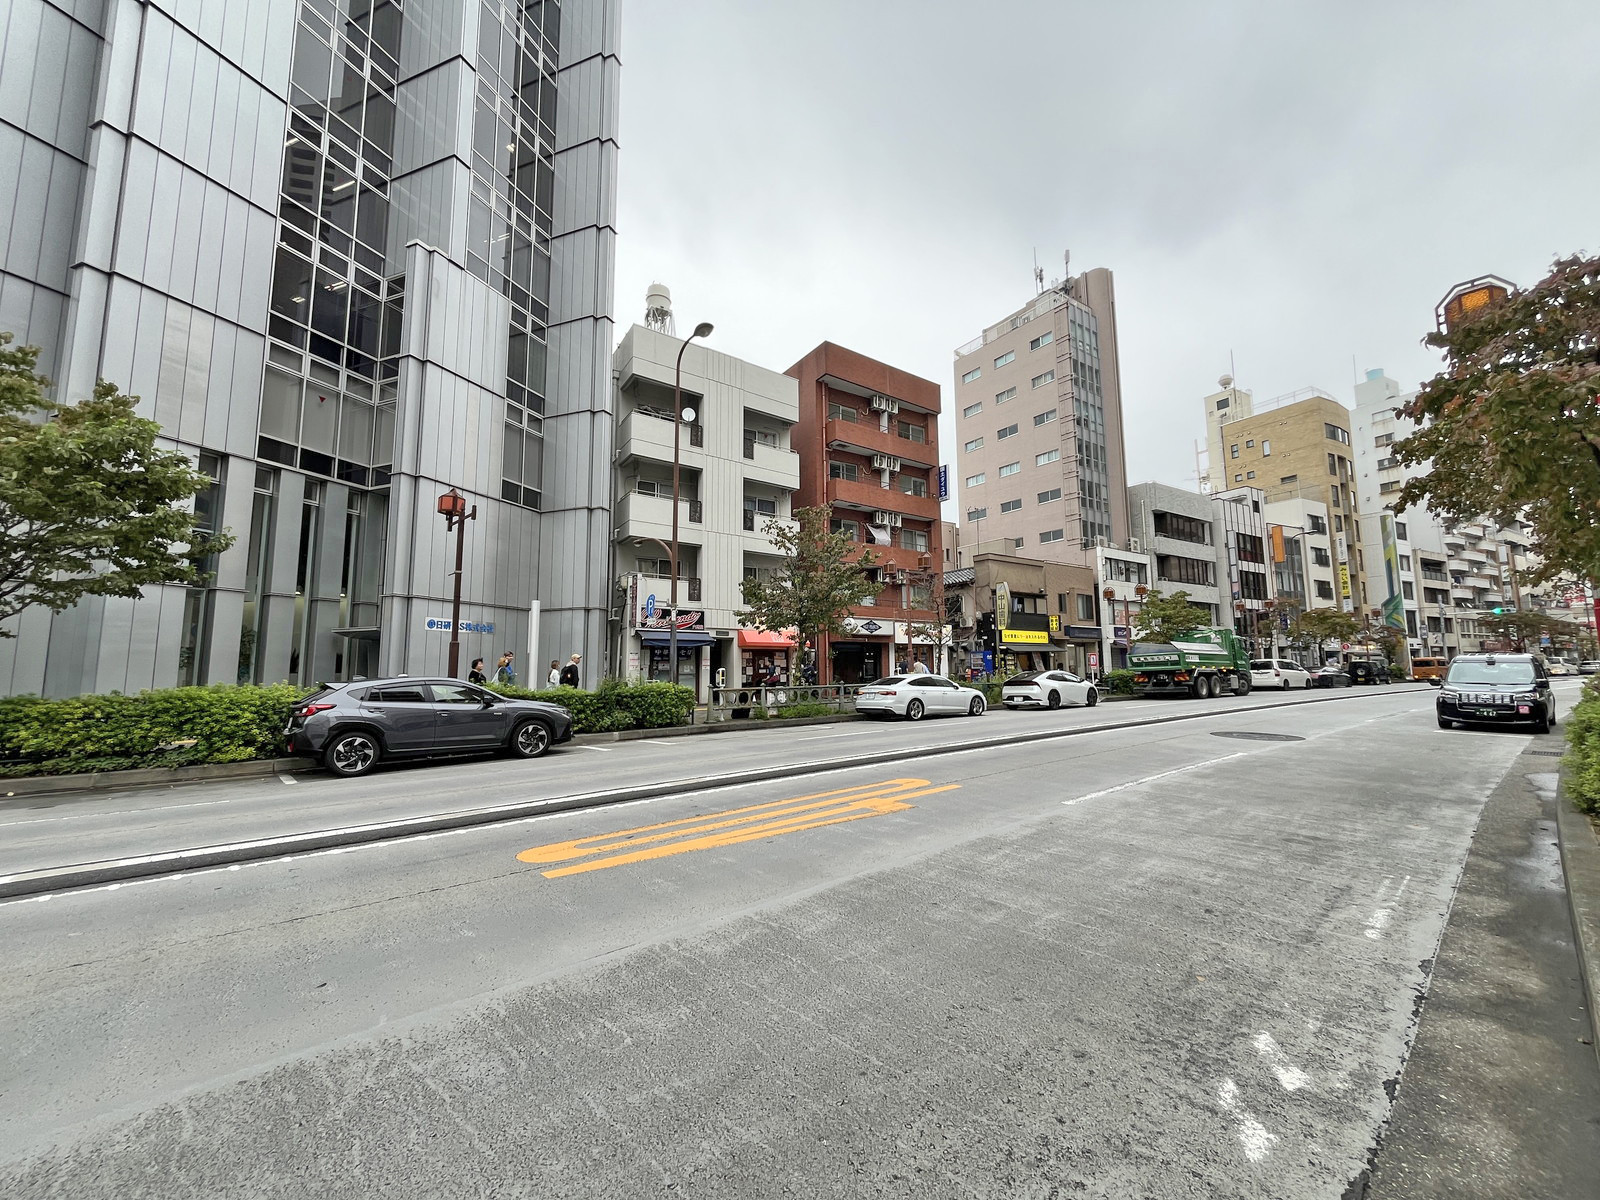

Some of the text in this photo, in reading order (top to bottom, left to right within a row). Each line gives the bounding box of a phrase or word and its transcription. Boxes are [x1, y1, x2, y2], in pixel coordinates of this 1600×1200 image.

[648, 599, 654, 616] P
[436, 620, 494, 634] 日研S株式会社
